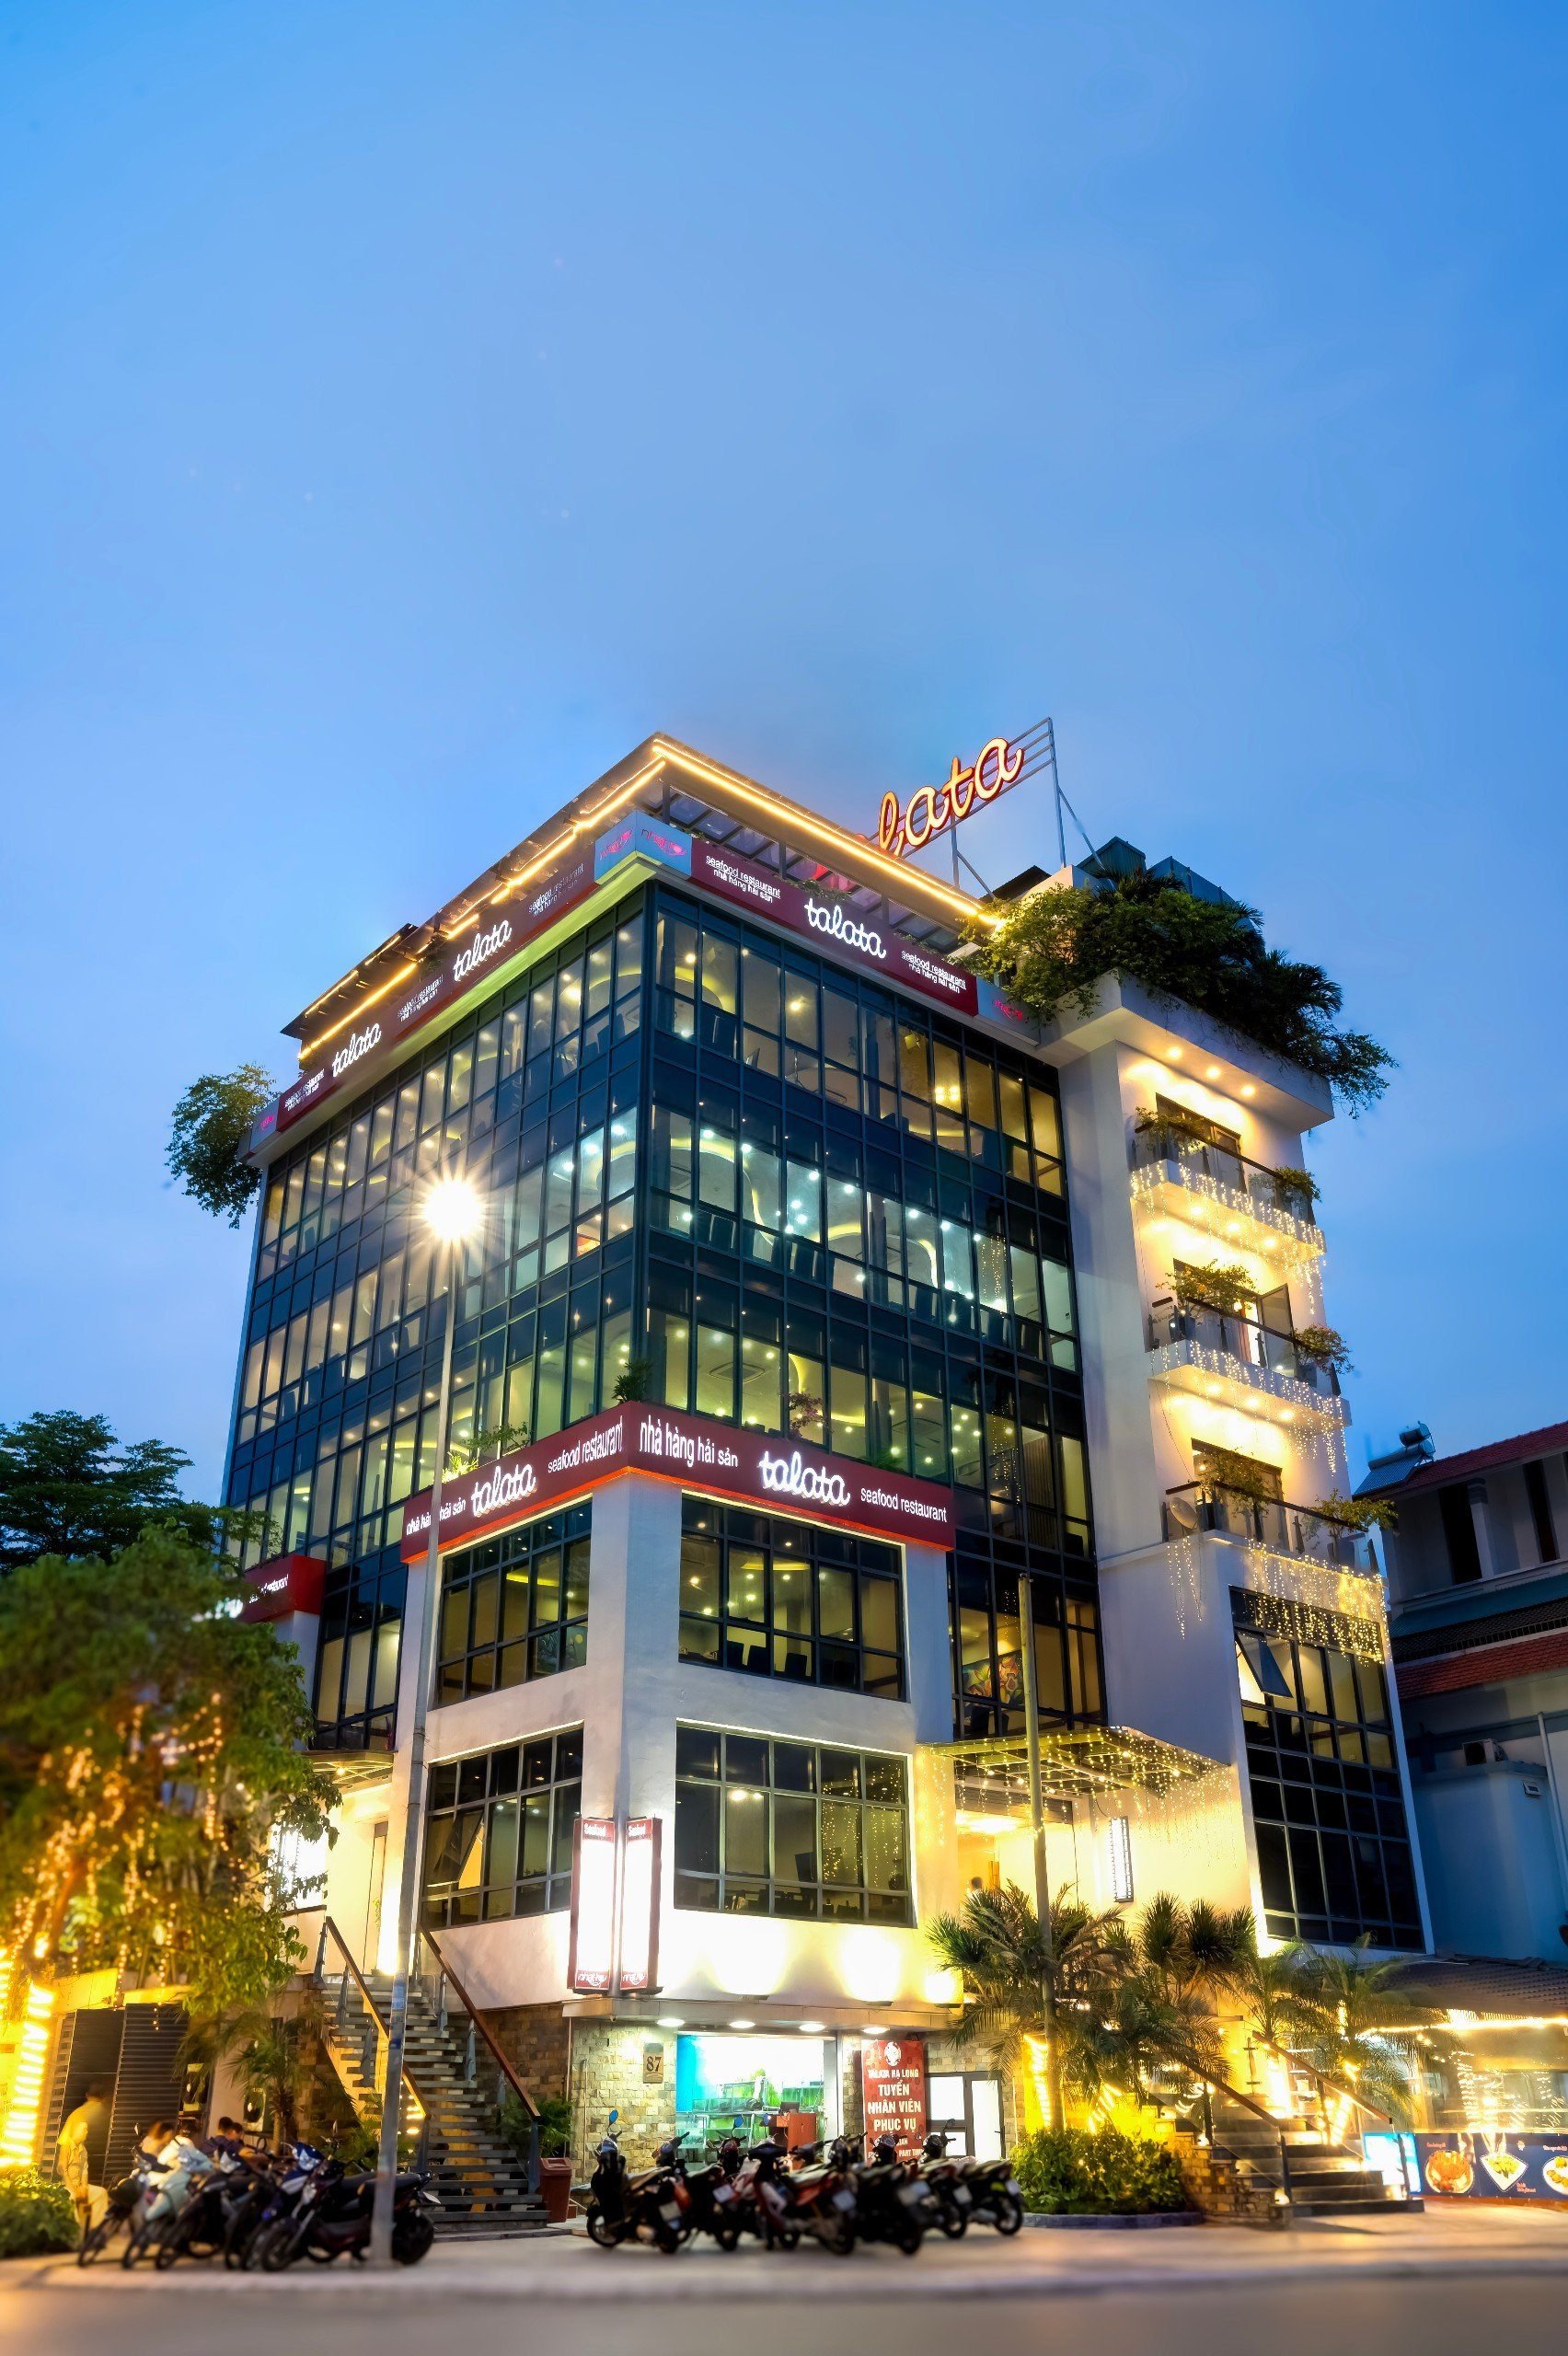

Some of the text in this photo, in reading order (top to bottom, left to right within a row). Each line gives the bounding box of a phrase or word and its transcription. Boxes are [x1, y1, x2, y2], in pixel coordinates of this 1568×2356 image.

[706, 855, 781, 899] seafood restaurant
[453, 920, 513, 982] talata
[804, 897, 887, 958] talata
[332, 1022, 382, 1077] talata
[421, 1511, 432, 1530] hà
[470, 1463, 537, 1518] talata
[548, 1439, 581, 1473] seafood
[582, 1415, 623, 1464] restaurant
[640, 1415, 948, 1523] nhà hàng hải sản talata seafood restaurant
[646, 2056, 663, 2072] 87
[902, 2068, 919, 2078] LONG
[867, 2097, 922, 2115] NHÂN VIÊN
[873, 2118, 917, 2134] PHỤC VỤ
